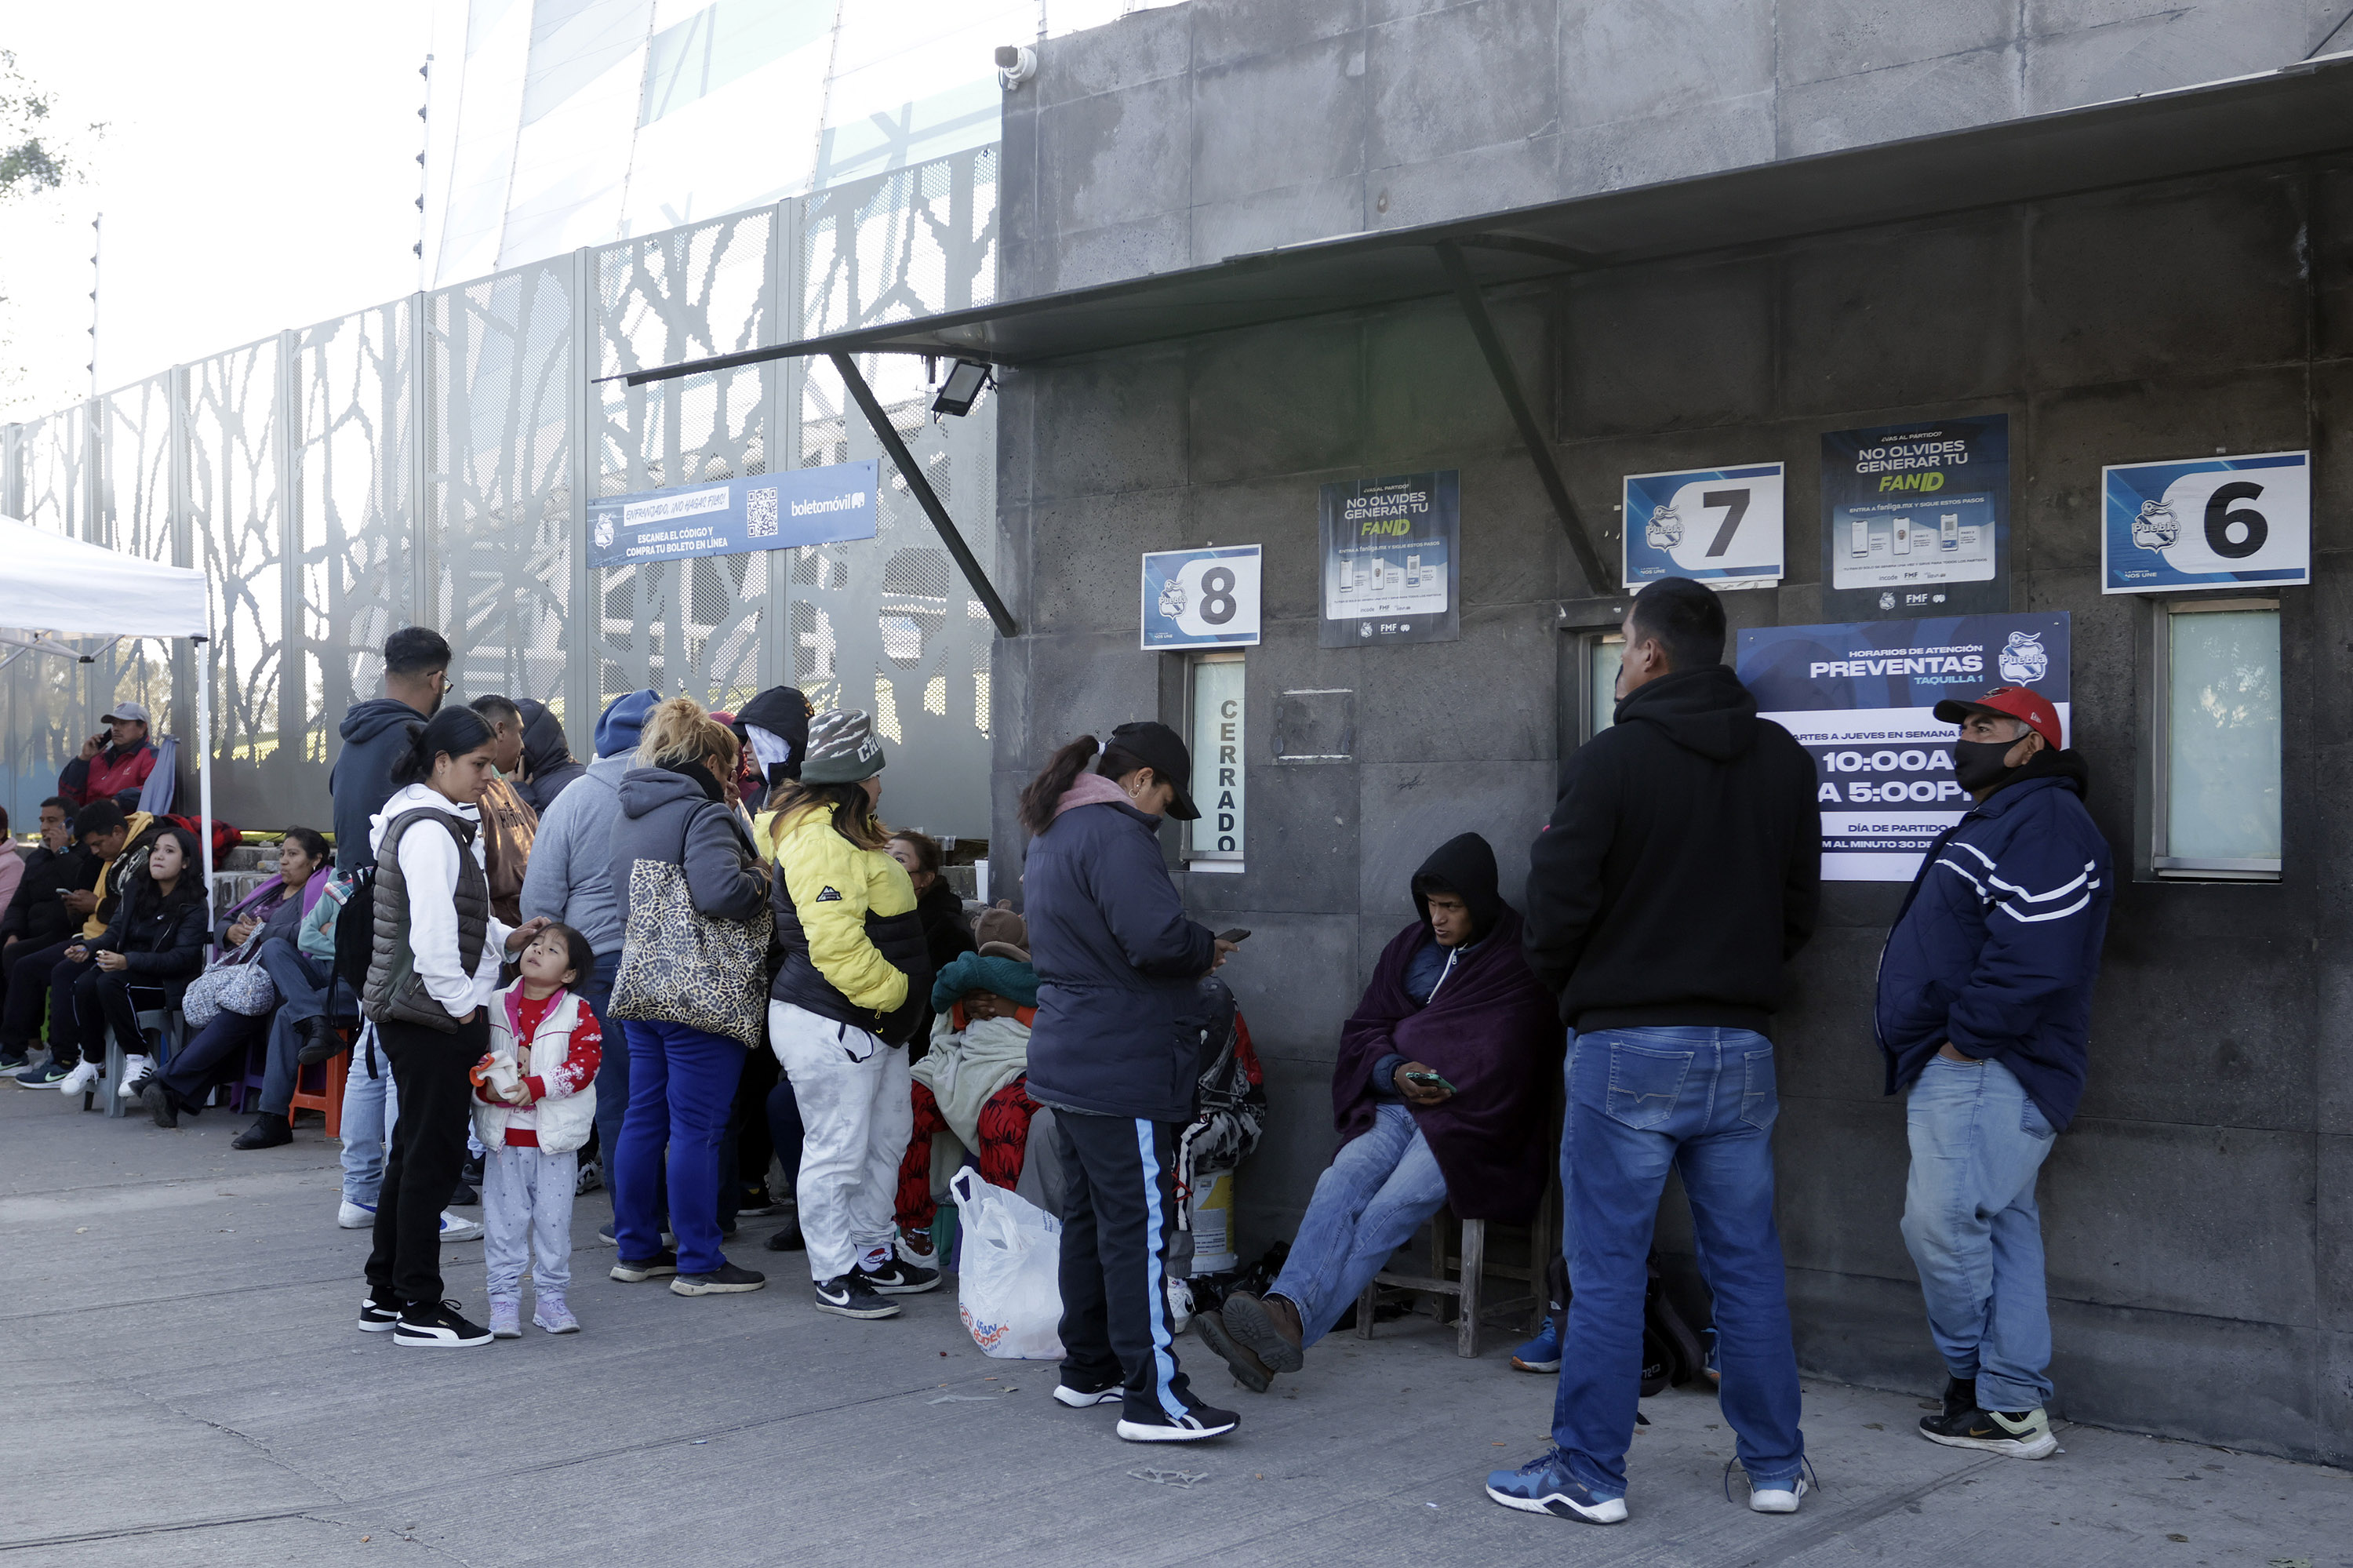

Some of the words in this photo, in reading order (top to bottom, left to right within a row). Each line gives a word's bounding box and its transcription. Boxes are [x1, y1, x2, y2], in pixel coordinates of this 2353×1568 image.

[1909, 431, 1943, 439] PARTIDO?
[1859, 448, 1886, 460] NO
[1889, 440, 1965, 457] OLVIDES
[1856, 456, 1940, 474] GENERAR
[1944, 453, 1968, 465] TU
[685, 496, 707, 511] HAGAS
[707, 493, 727, 509] FILAS!
[791, 493, 851, 516] boletomóvil
[1347, 498, 1366, 508] NO
[1369, 492, 1426, 507] OLVIDES
[1877, 503, 1913, 511] fanliga.mx
[1344, 504, 1407, 519] GENERAR
[1410, 502, 1428, 513] TU
[1703, 488, 1750, 557] 7
[2133, 522, 2180, 534] Puebla
[2204, 482, 2268, 558] 6
[638, 533, 669, 544] ESCANEA
[670, 531, 678, 540] EL
[679, 527, 707, 539] CÓDIGO
[707, 526, 714, 536] Y
[1647, 525, 1684, 535] Puebla
[627, 546, 655, 557] COMPRA
[656, 544, 665, 554] TU
[666, 541, 694, 553] BOLETO
[696, 540, 706, 550] EN
[707, 537, 728, 548] LÍNEA
[1159, 595, 1187, 605] Puebla
[1199, 566, 1236, 625] 8
[1906, 594, 1928, 603] FMF
[1849, 648, 1907, 657] HORARIOS
[1925, 645, 1983, 654] ATENCIÓN
[2000, 654, 2047, 665] Puebla
[1810, 655, 1984, 678] PREVENTAS
[1914, 675, 1975, 686] TAQUILLA
[1842, 731, 1885, 740] JUEVES
[1905, 730, 1956, 739] SEMANA
[1823, 750, 1956, 772] 10:00A
[1217, 700, 1238, 852] CERRADO
[1818, 782, 1842, 802] A
[1849, 780, 1973, 802] 5:00P
[1849, 824, 1869, 832] DÍA
[1850, 840, 1897, 849] MINUTO
